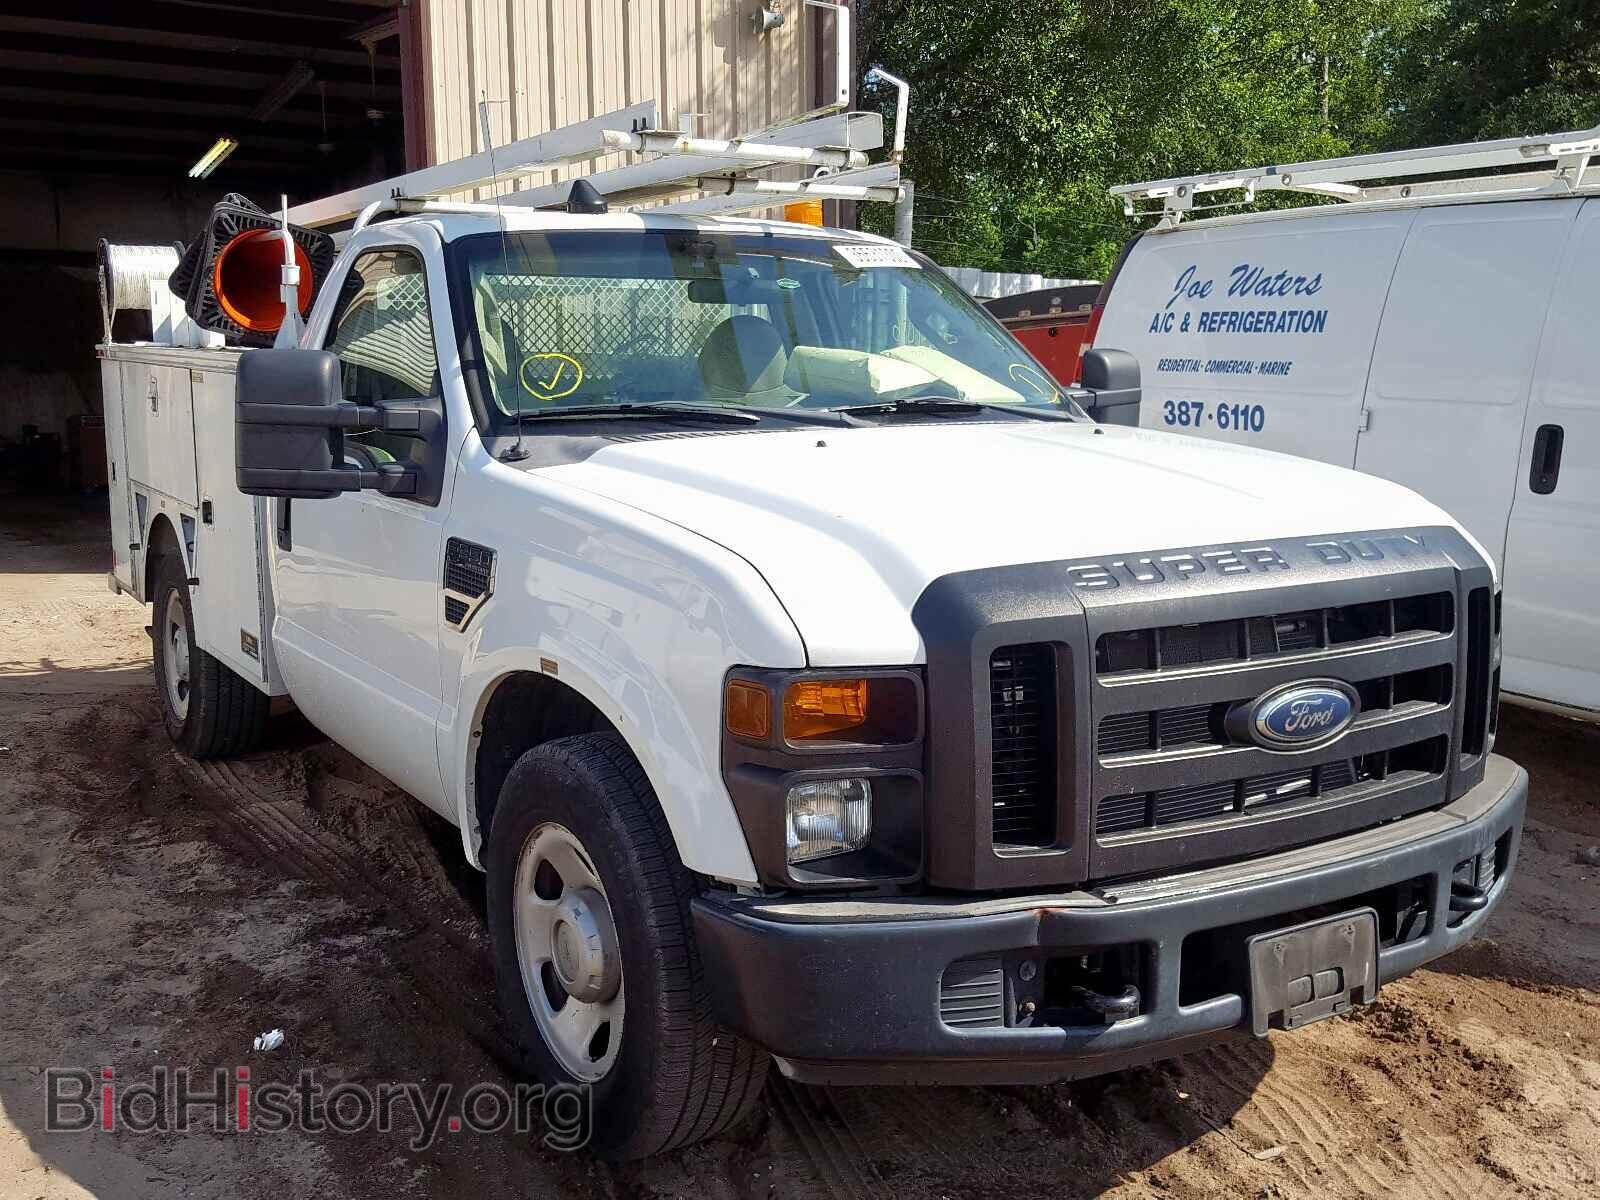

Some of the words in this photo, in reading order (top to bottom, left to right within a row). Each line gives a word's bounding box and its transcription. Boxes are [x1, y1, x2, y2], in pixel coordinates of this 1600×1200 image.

[1165, 264, 1213, 310] Joe
[1228, 263, 1322, 297] Waters
[1149, 311, 1175, 333] A/C
[1180, 311, 1190, 333] &
[1197, 310, 1328, 333] REFRIGERATION
[1157, 358, 1201, 373] RESIDENTIAL
[1204, 359, 1254, 374] COMMERCIAL
[1258, 361, 1292, 376] MARINE
[1067, 546, 1290, 590] SUPER
[1305, 533, 1426, 566] DUTY
[1284, 697, 1336, 732] Ford
